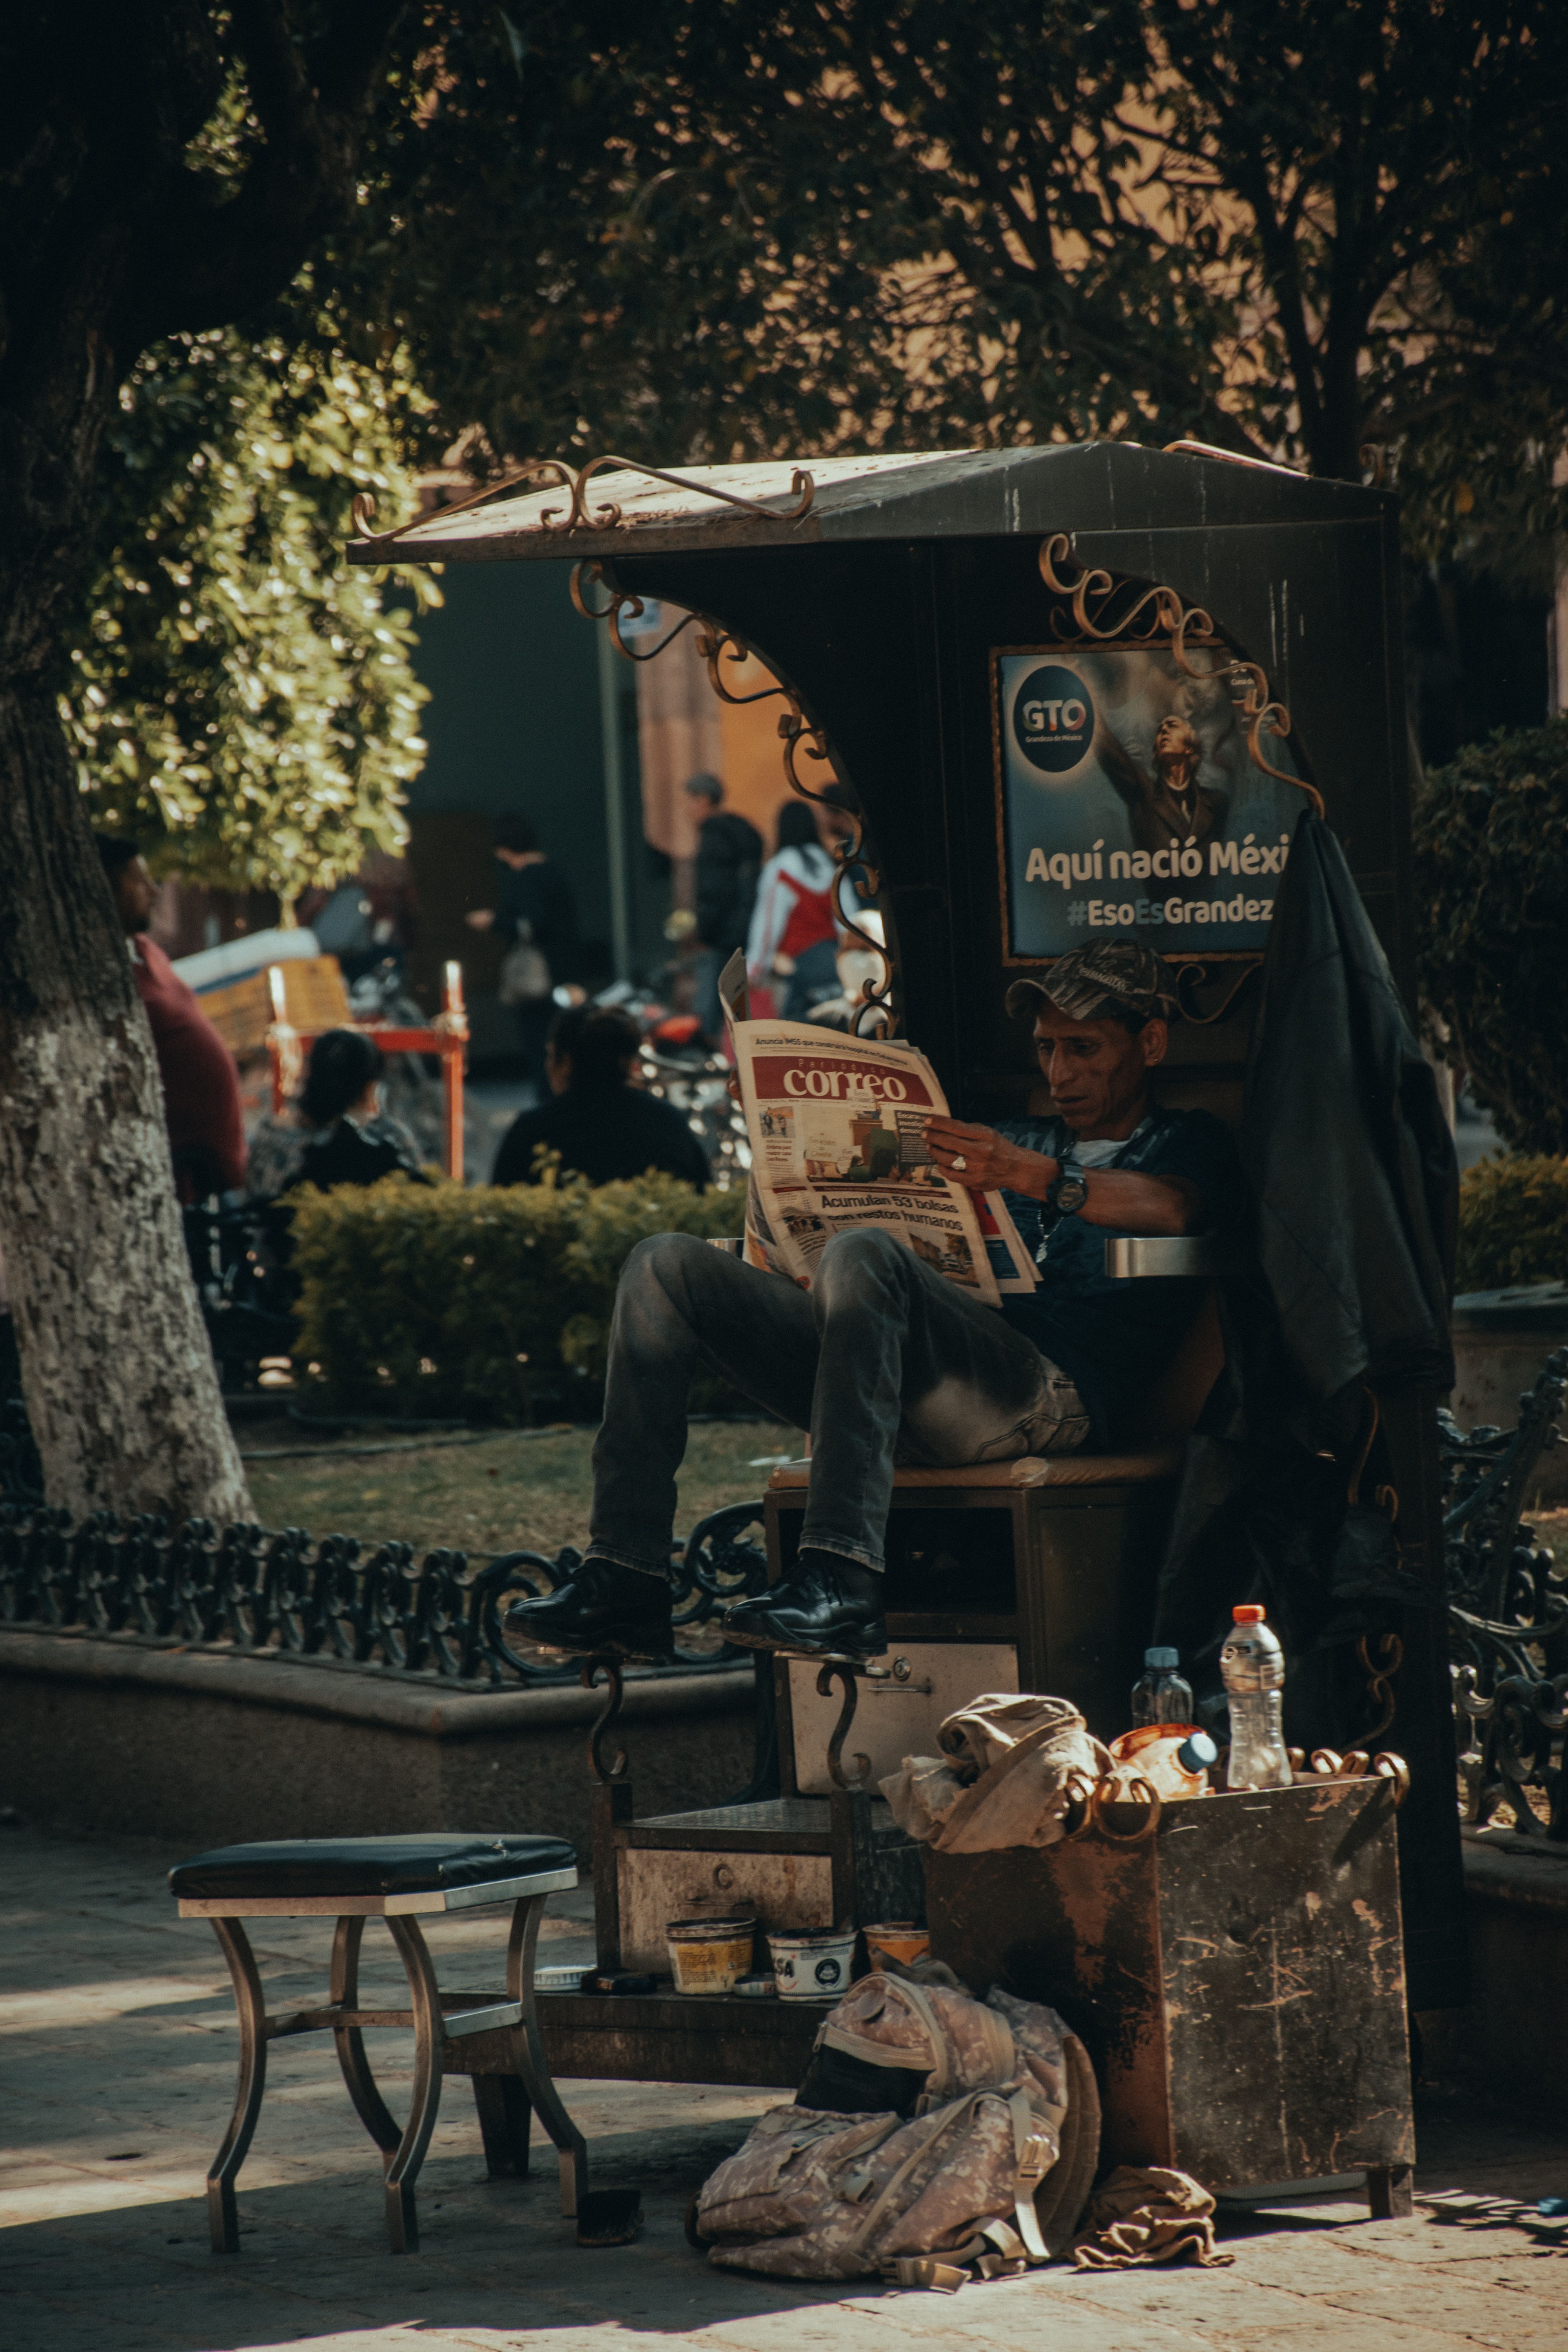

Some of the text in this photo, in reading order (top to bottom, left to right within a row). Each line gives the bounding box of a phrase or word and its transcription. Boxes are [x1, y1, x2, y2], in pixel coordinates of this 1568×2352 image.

[1022, 699, 1086, 732] GTO
[1025, 833, 1289, 890] Aquí nació Méxi
[1067, 894, 1274, 926] #EsoEsGrandez
[783, 1069, 907, 1100] correo
[822, 1195, 891, 1209] Acumulan
[891, 1196, 913, 1208] 53
[914, 1198, 958, 1213] bolsas
[827, 1210, 964, 1231] con restos humanos
